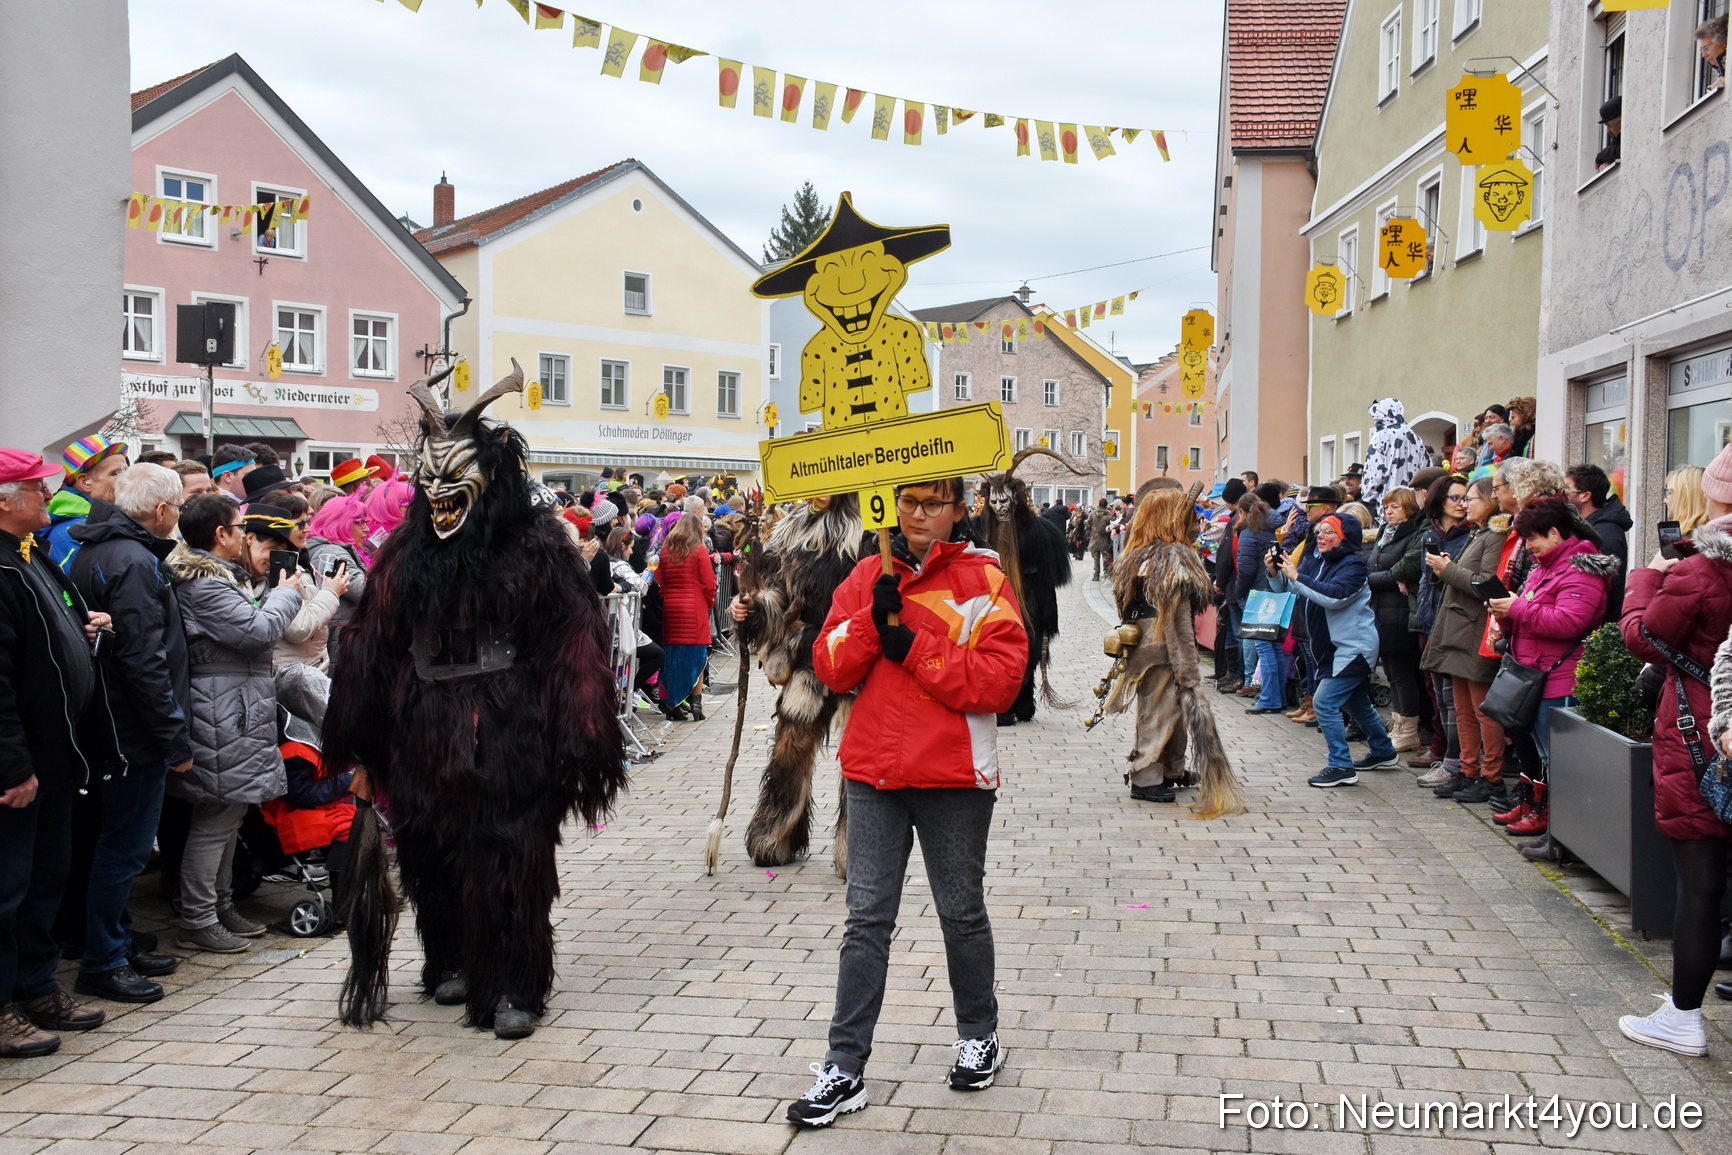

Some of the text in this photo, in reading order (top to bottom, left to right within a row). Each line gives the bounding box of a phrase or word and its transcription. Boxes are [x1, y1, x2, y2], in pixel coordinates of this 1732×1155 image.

[1494, 114, 1512, 135] 华
[1457, 137, 1472, 154] 人
[1385, 251, 1400, 269] 人
[1406, 241, 1423, 262] 华
[173, 384, 196, 398] zur
[213, 386, 235, 398] ost
[274, 388, 351, 405] Niedermeier
[598, 424, 692, 444] Schuhmoden Döllinger
[790, 451, 871, 479] Altmühltaler
[870, 495, 885, 524] 9
[1684, 661, 1705, 678] 1981
